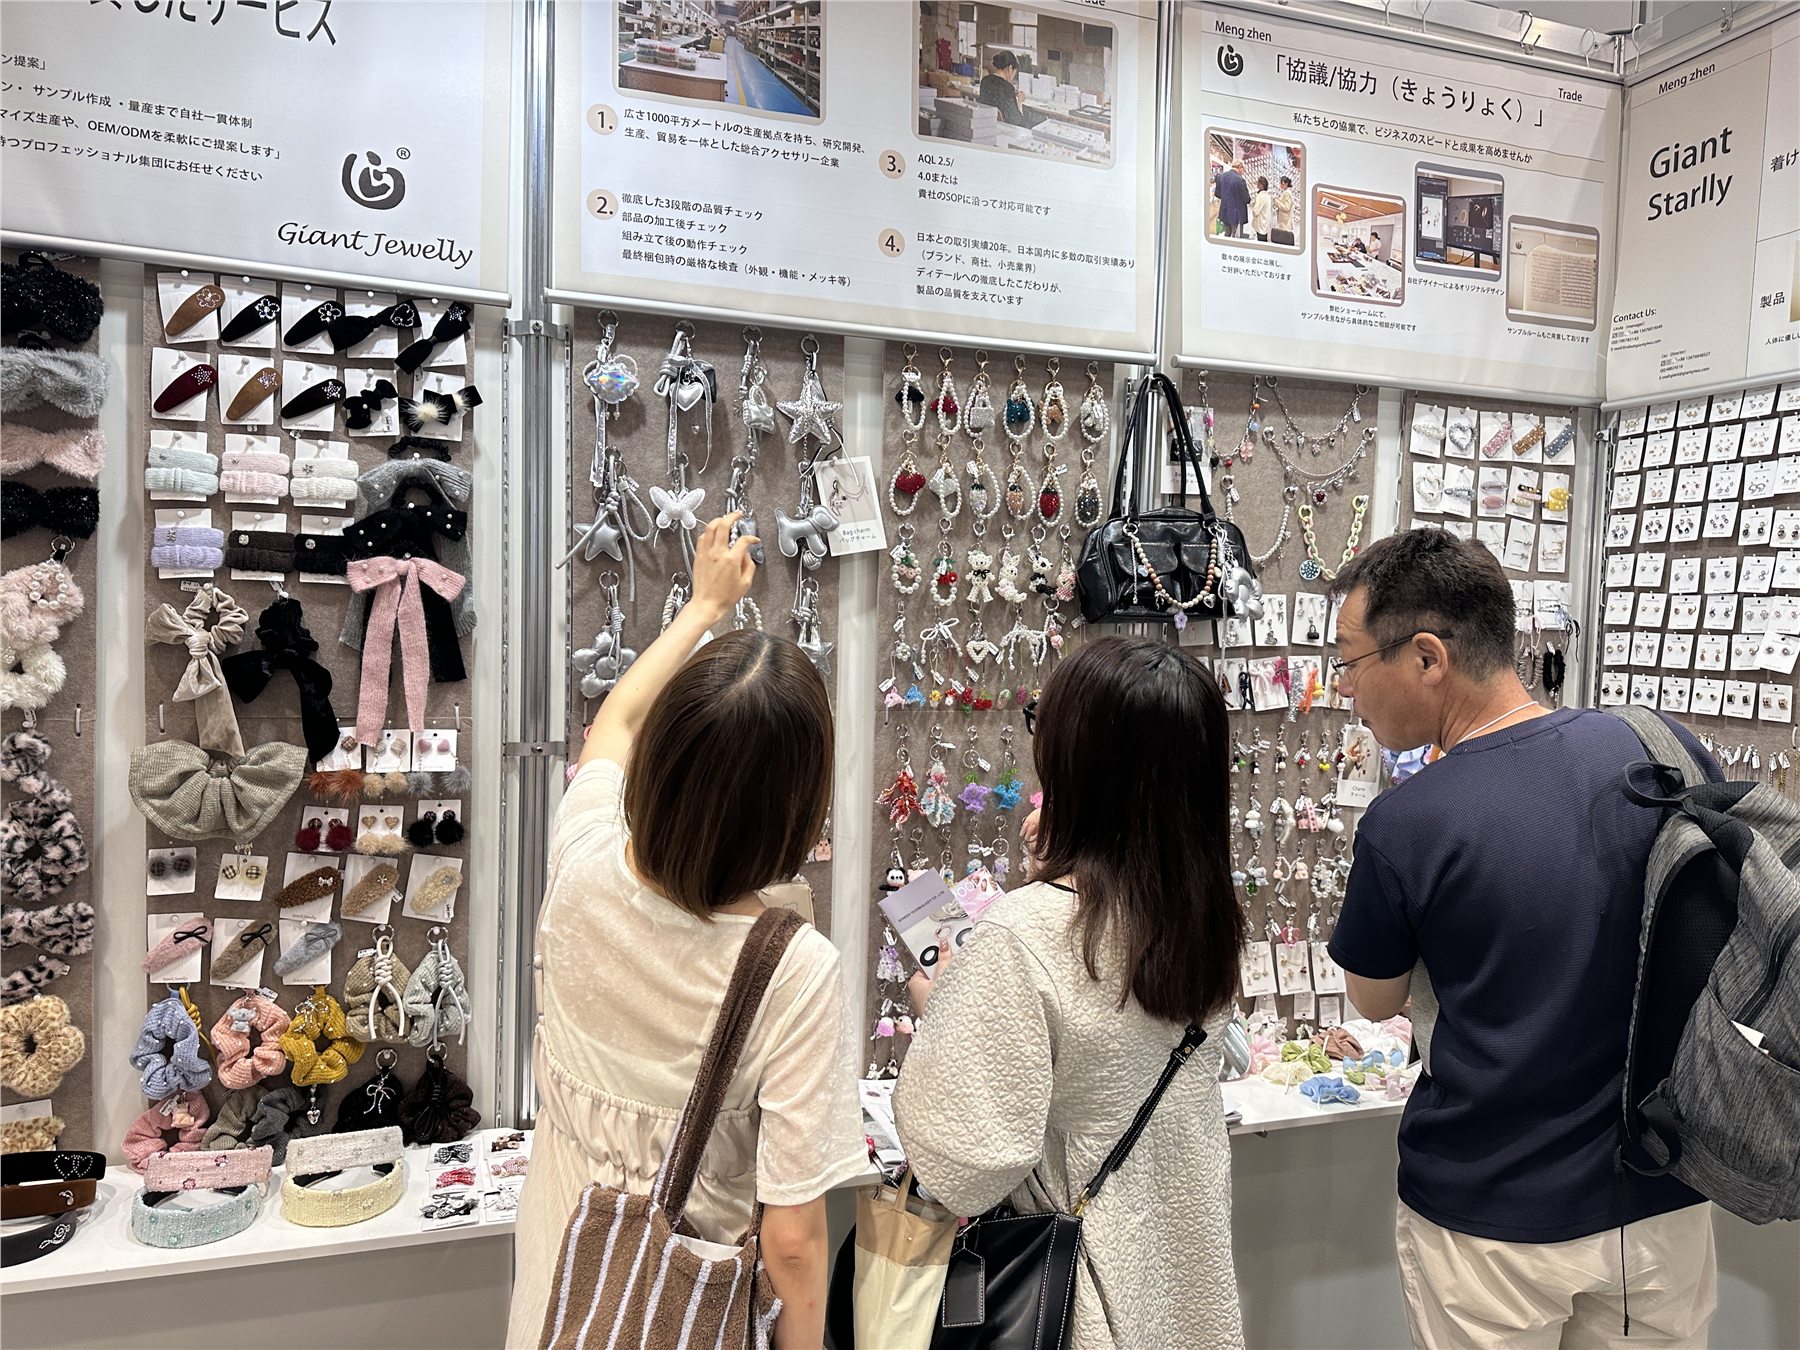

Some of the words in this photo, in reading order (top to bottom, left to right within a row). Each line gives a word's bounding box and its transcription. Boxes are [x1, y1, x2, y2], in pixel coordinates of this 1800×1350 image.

[1215, 20, 1245, 42] Meng
[1247, 25, 1272, 42] zhen
[1658, 76, 1687, 94] Meng
[1690, 63, 1716, 81] zhen
[1276, 54, 1544, 128] 「協議/協力（きょうりょく）」
[1558, 87, 1583, 102] Trade
[597, 111, 614, 130] 1.
[624, 127, 840, 169] 生産、貿易を一体とした総合アクセサリー企業
[1650, 127, 1733, 179] Giant
[886, 155, 902, 174] 3.
[918, 153, 936, 165] AQL
[938, 156, 954, 168] 2.5/
[917, 172, 959, 186] 4.0または
[596, 196, 614, 215] 2.
[621, 192, 763, 221] 徹底した3段階の品質チェック
[917, 188, 1051, 216] 貴社のSOPに沿って対応可能です
[1647, 172, 1733, 221] Starlly
[621, 211, 727, 234] 部品の加工後チェック
[277, 222, 368, 250] Giant
[364, 233, 473, 270] Jewelly
[621, 230, 748, 255] 組み立て後の動作チェック
[885, 235, 900, 252] 4.
[921, 250, 1037, 275] （ブランド、商社、小売業界）
[916, 267, 1062, 294] ディテールへの徹底したこだわりが、
[916, 284, 1024, 306] 製品の品質を支えています
[1760, 291, 1785, 308] 製品
[1613, 310, 1644, 323] Contact
[1645, 308, 1657, 318] Us:
